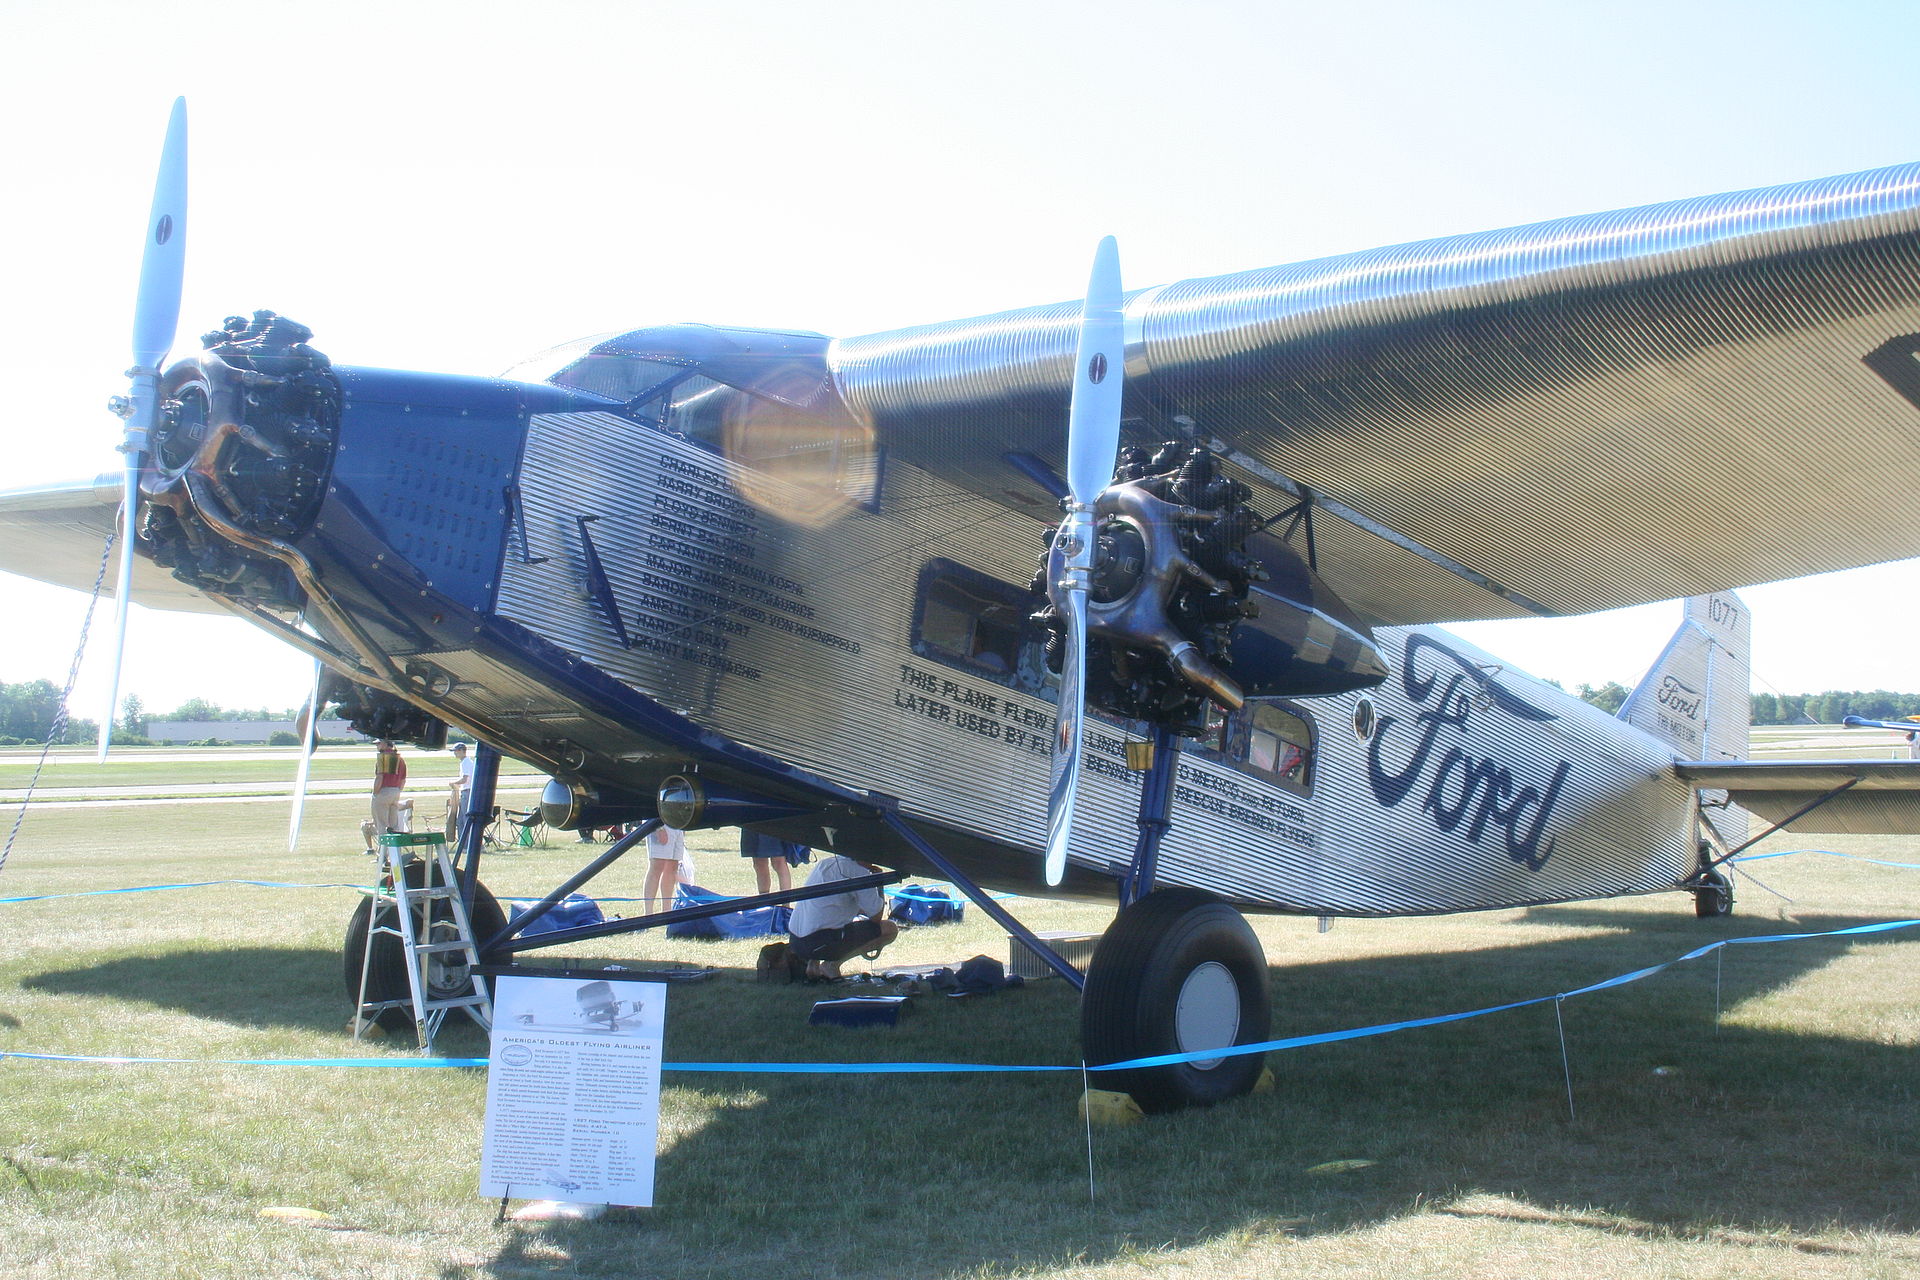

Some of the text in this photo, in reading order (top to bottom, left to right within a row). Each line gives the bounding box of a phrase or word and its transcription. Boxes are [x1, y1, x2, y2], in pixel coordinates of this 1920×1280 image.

[660, 454, 720, 487] CHARLES
[653, 494, 759, 539] FLOYD BENNETT
[656, 473, 756, 520] HARRY BROOKS
[650, 513, 696, 538] BERNT
[648, 534, 706, 564] CAPTAIN
[646, 552, 692, 579] MAJOR
[695, 569, 736, 594] JAMES
[640, 592, 751, 638] AMELIA EARHART
[642, 572, 689, 598] BARON
[768, 613, 800, 634] VON
[1708, 594, 1738, 631] 1077
[636, 612, 692, 641] HAROLD
[900, 664, 938, 694] THIS
[942, 679, 999, 715] PLANE
[1003, 700, 1048, 731] FLEW
[1657, 675, 1702, 720] Ford
[894, 688, 951, 723] LATER
[954, 709, 1001, 739] USED
[1004, 724, 1027, 747] BY
[1087, 752, 1144, 786] BENNET
[1174, 785, 1225, 815] RESCUE
[1367, 633, 1571, 873] Ford
